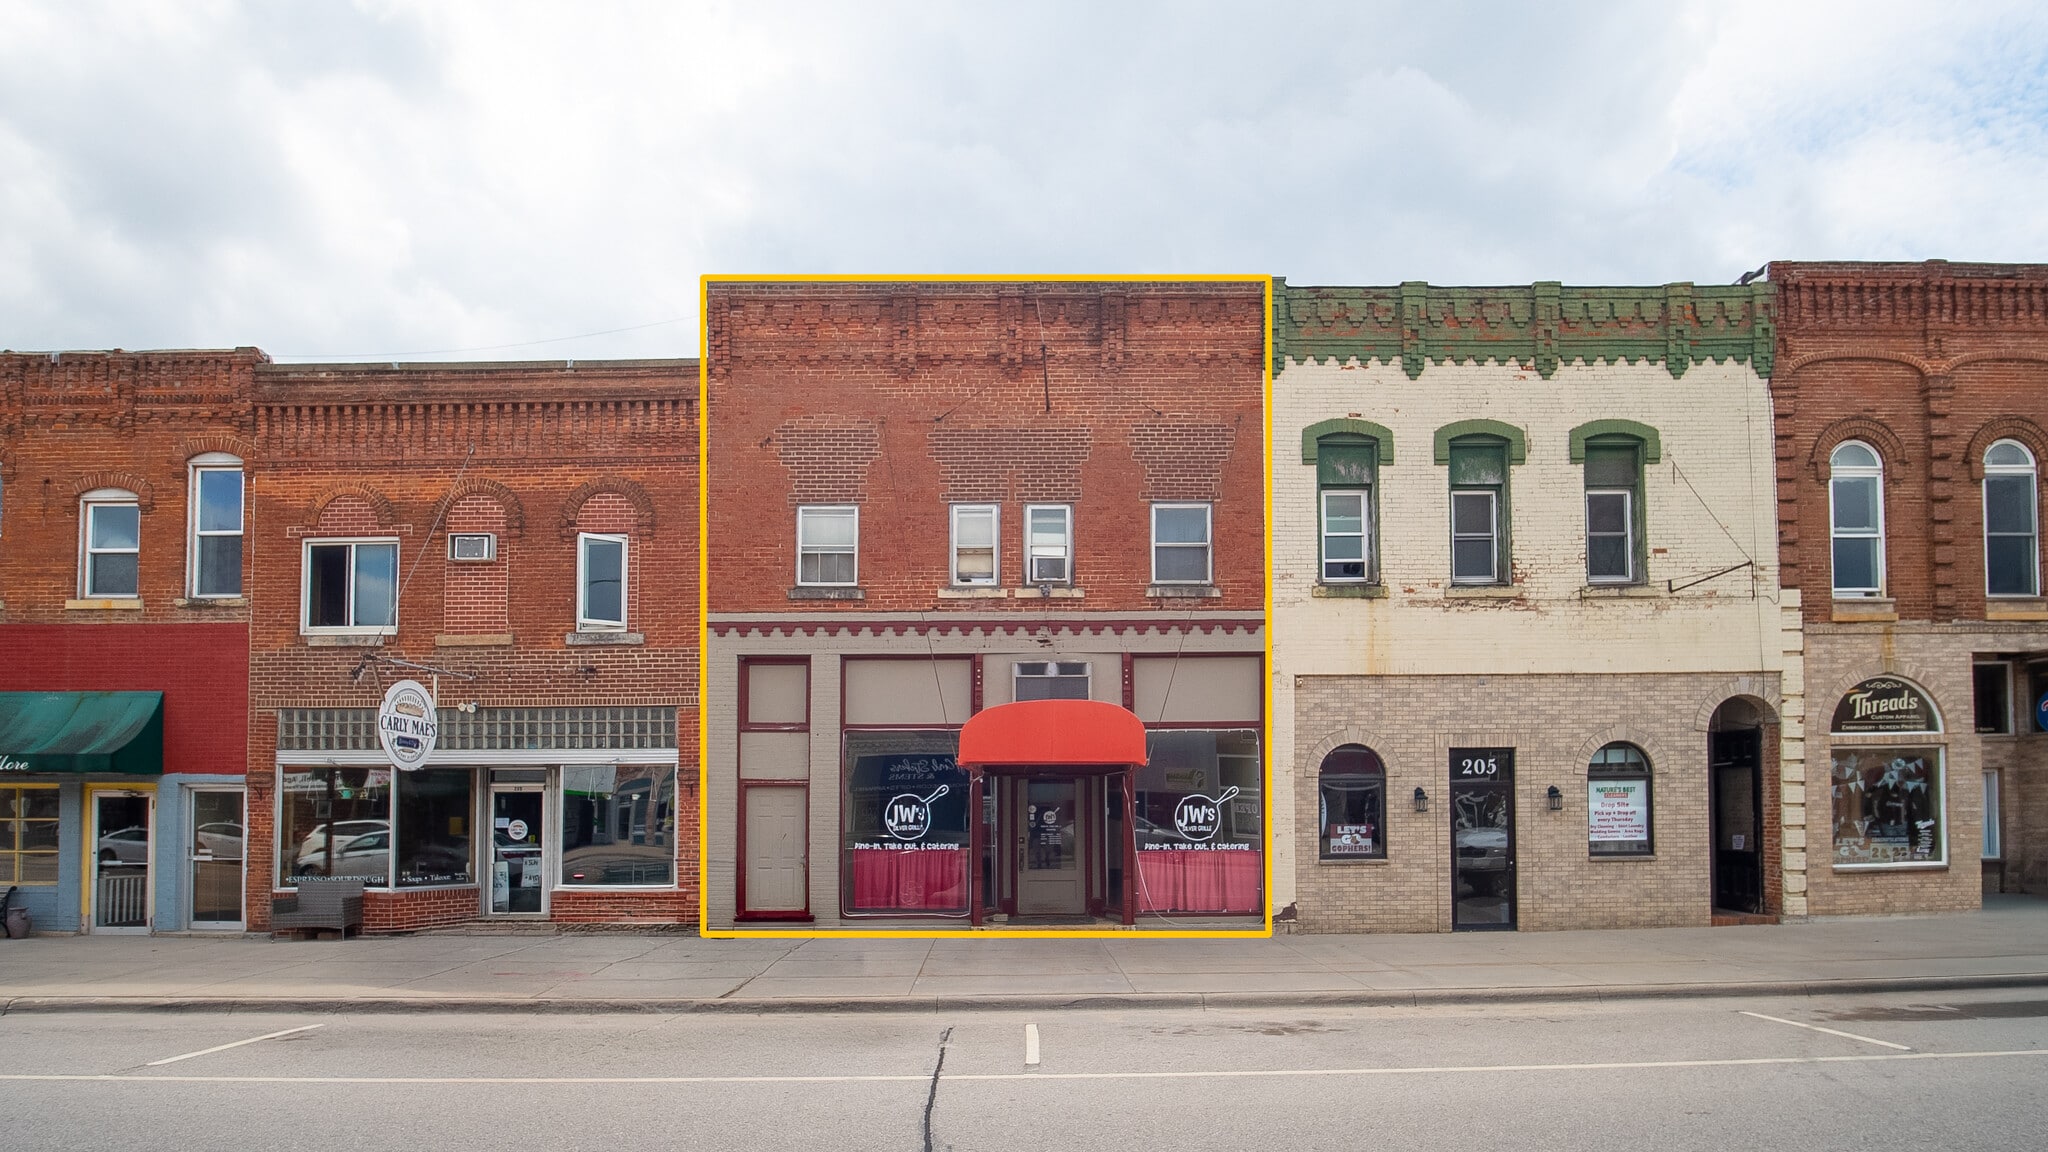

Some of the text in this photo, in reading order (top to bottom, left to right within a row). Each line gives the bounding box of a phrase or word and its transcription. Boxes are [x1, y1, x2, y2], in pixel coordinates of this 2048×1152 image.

[1849, 690, 1918, 719] Threads
[380, 714, 437, 738] CARLY MAE'S
[1462, 758, 1497, 775] 205
[1337, 825, 1367, 834] LET'S
